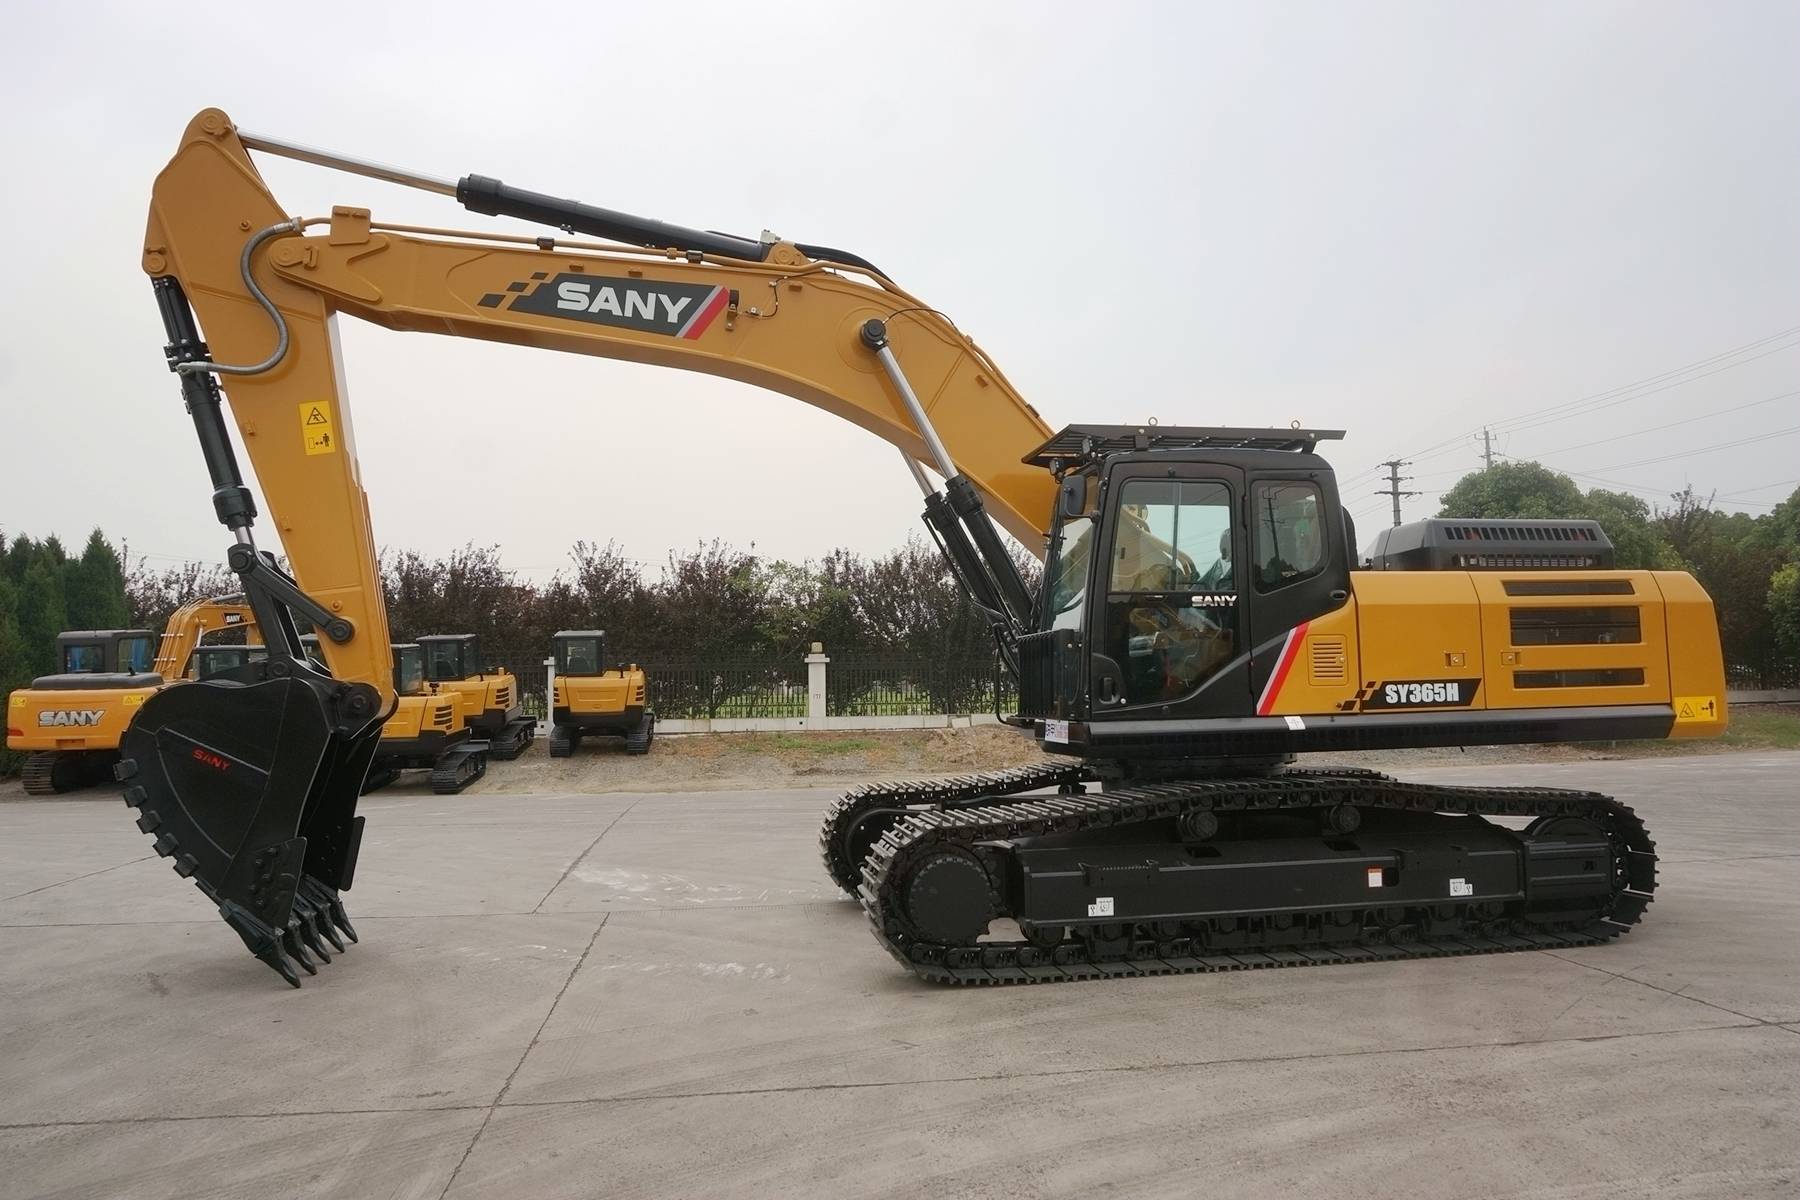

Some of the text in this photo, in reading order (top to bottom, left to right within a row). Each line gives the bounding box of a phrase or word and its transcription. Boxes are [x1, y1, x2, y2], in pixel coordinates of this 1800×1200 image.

[557, 281, 692, 323] SANY
[1191, 595, 1237, 607] SANY
[1385, 683, 1459, 703] SY365H
[39, 710, 105, 727] SANY
[192, 749, 231, 770] SANY
